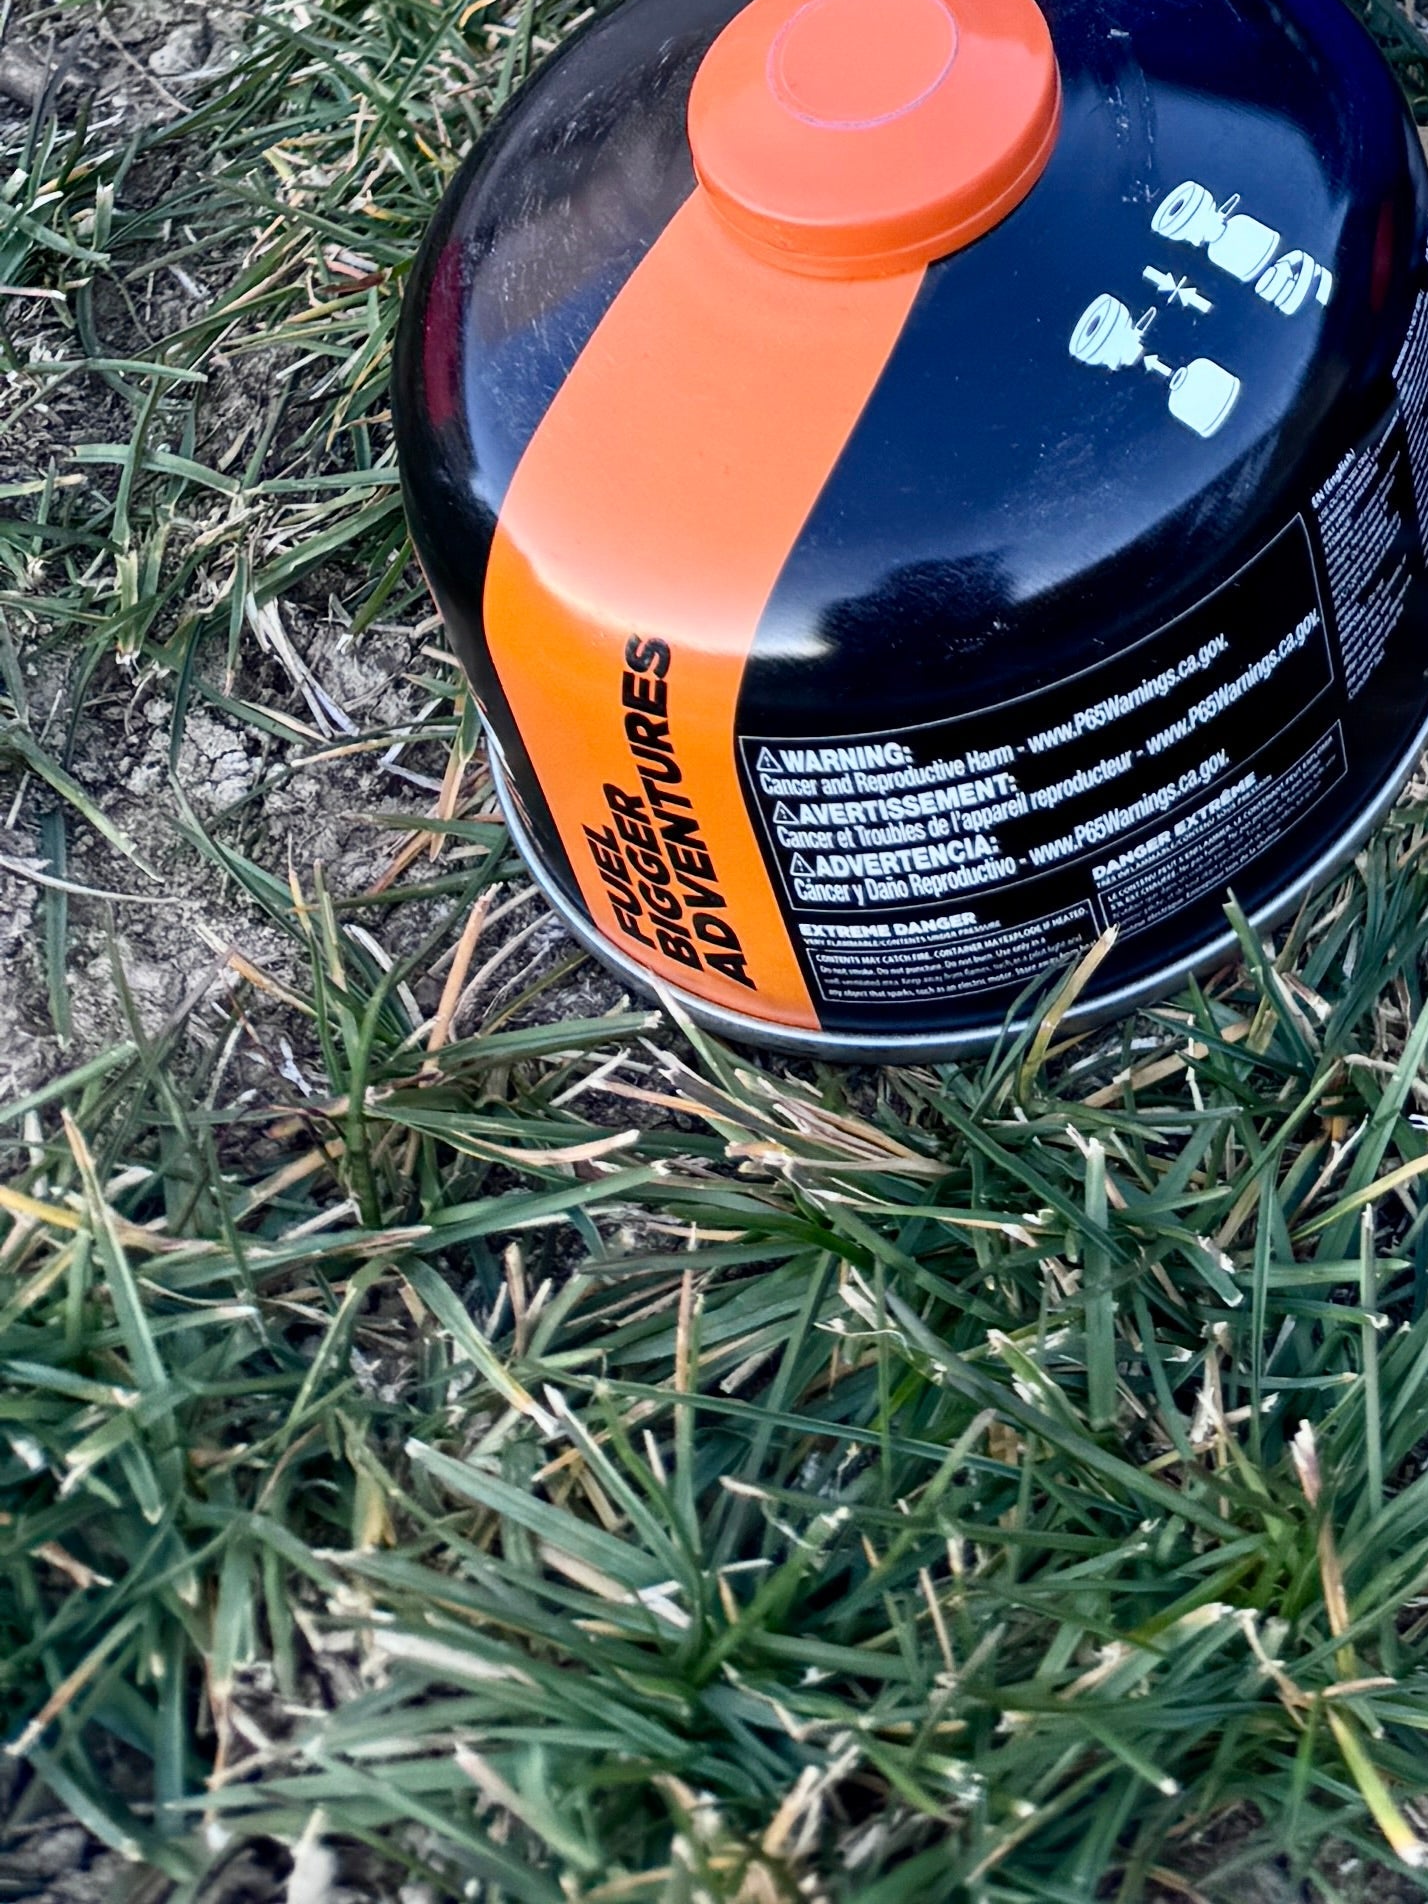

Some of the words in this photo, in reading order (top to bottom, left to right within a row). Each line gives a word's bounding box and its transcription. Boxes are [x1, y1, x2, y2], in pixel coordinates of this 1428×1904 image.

[759, 773, 818, 796] Cancer
[822, 774, 853, 794] and
[855, 758, 966, 795] Reproductive
[966, 743, 1016, 772] Harm
[779, 742, 915, 773] WARNING:
[621, 633, 758, 992] ADVENTURES
[777, 824, 834, 850] Cancer
[837, 827, 853, 847] et
[854, 815, 926, 847] Troubles
[928, 814, 949, 835] de
[1030, 750, 1133, 809] reproducteur
[799, 772, 1019, 826] AVERTISSEMENT:
[602, 782, 704, 972] BIGGER
[815, 835, 1001, 878] ADVERTENCIA:
[851, 885, 865, 907] y
[909, 856, 1017, 898] Reproductivo
[1092, 831, 1172, 881] DANGER
[582, 823, 657, 950] FUEL
[799, 923, 892, 938] EXTREME
[893, 912, 978, 936] DANGER
